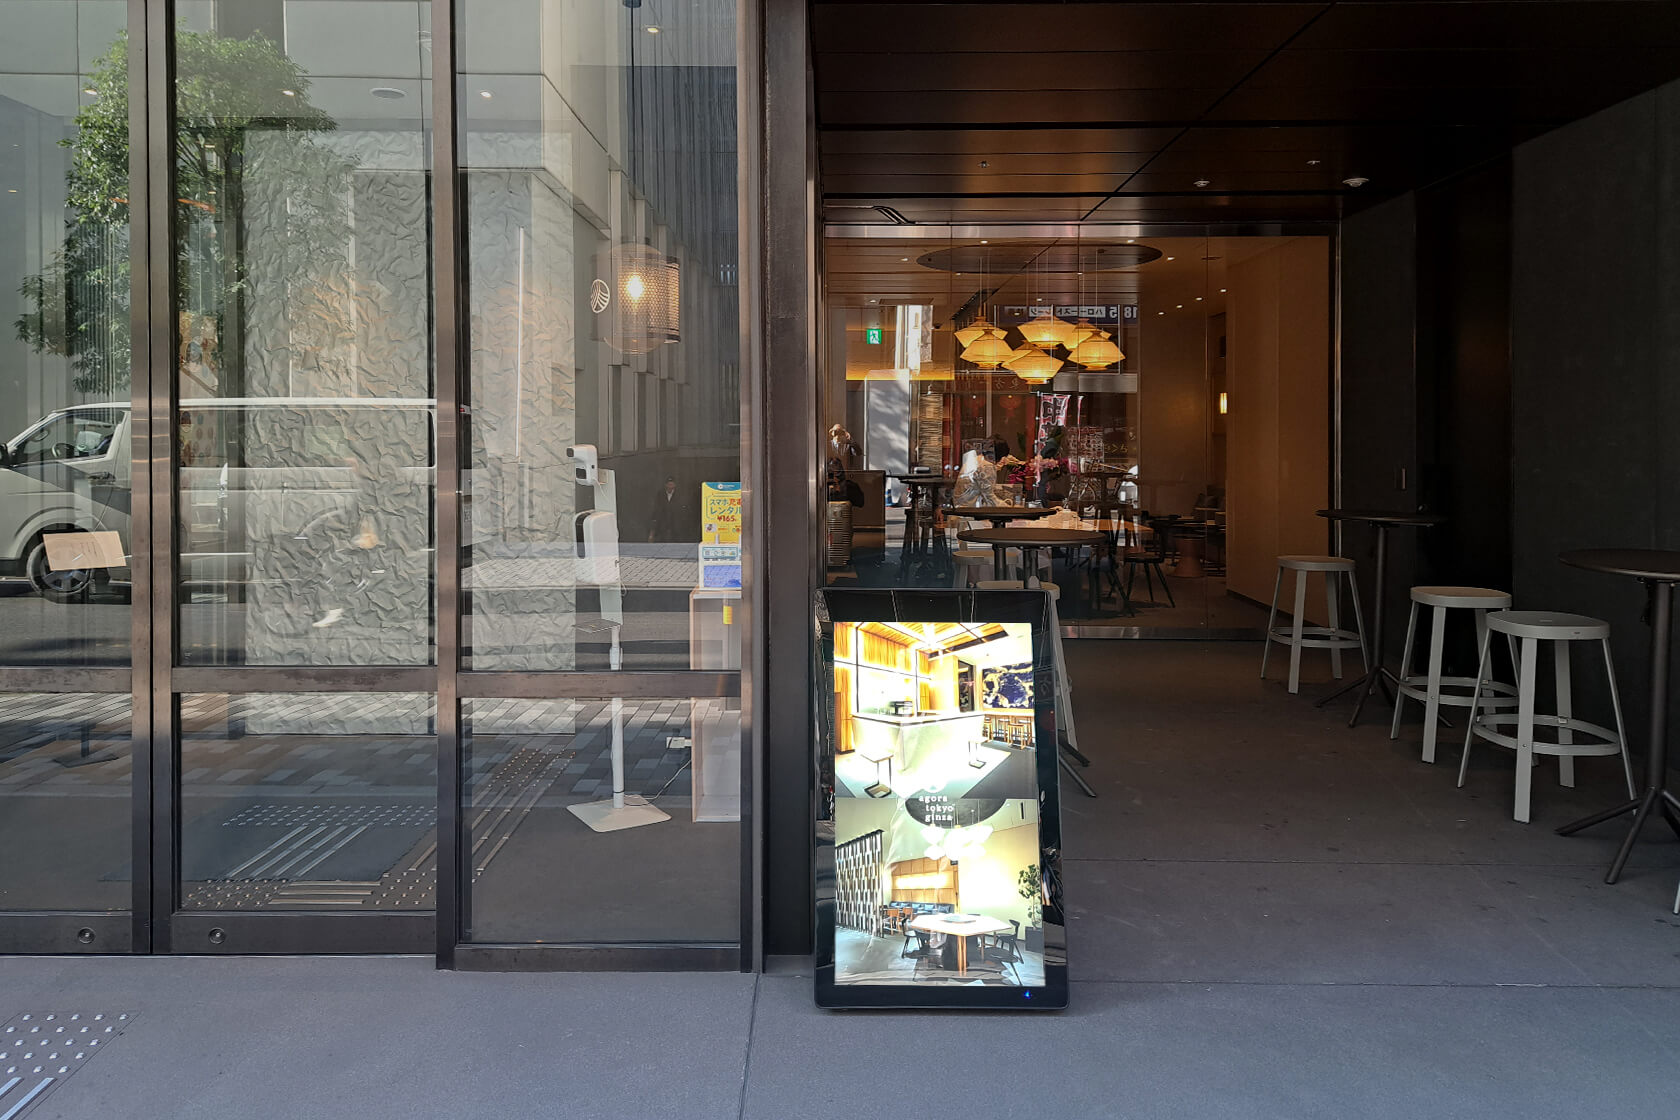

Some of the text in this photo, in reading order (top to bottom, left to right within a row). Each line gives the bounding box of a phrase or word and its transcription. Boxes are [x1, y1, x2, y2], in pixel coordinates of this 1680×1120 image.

[918, 795, 948, 804] agora
[925, 803, 954, 814] tokyo
[924, 813, 953, 823] ginza
